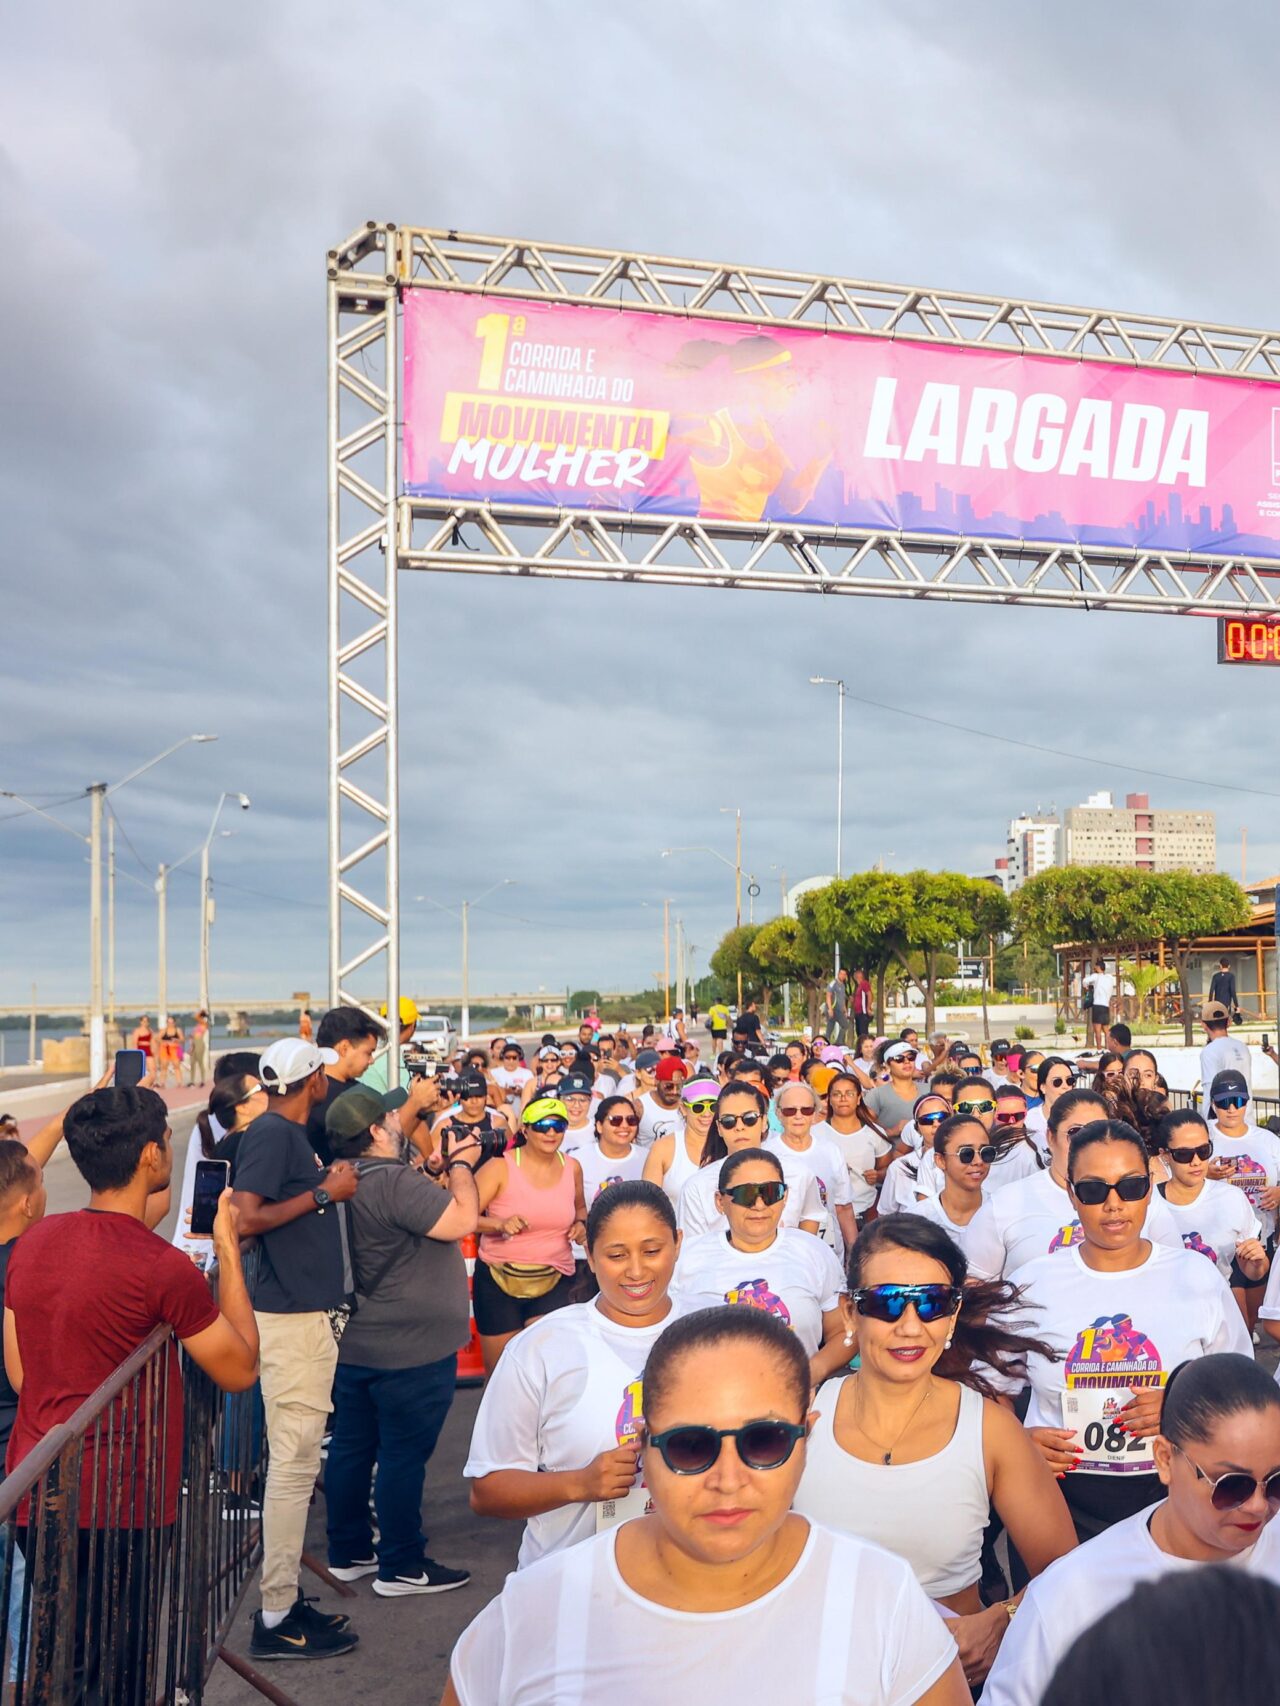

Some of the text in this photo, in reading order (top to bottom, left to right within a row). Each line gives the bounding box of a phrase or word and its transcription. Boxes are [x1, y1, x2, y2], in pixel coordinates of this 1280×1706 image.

[474, 312, 526, 392] 1ª
[508, 342, 595, 372] CORRIDA E
[504, 368, 634, 402] CAMINHADA DO
[456, 400, 655, 452] MOVIMENTA
[863, 376, 1210, 488] LARGADA
[447, 437, 650, 489] MULHER
[1071, 1360, 1157, 1374] CORRIDA E CAMINHADA DO
[1074, 1374, 1161, 1389] MOVIMENTA
